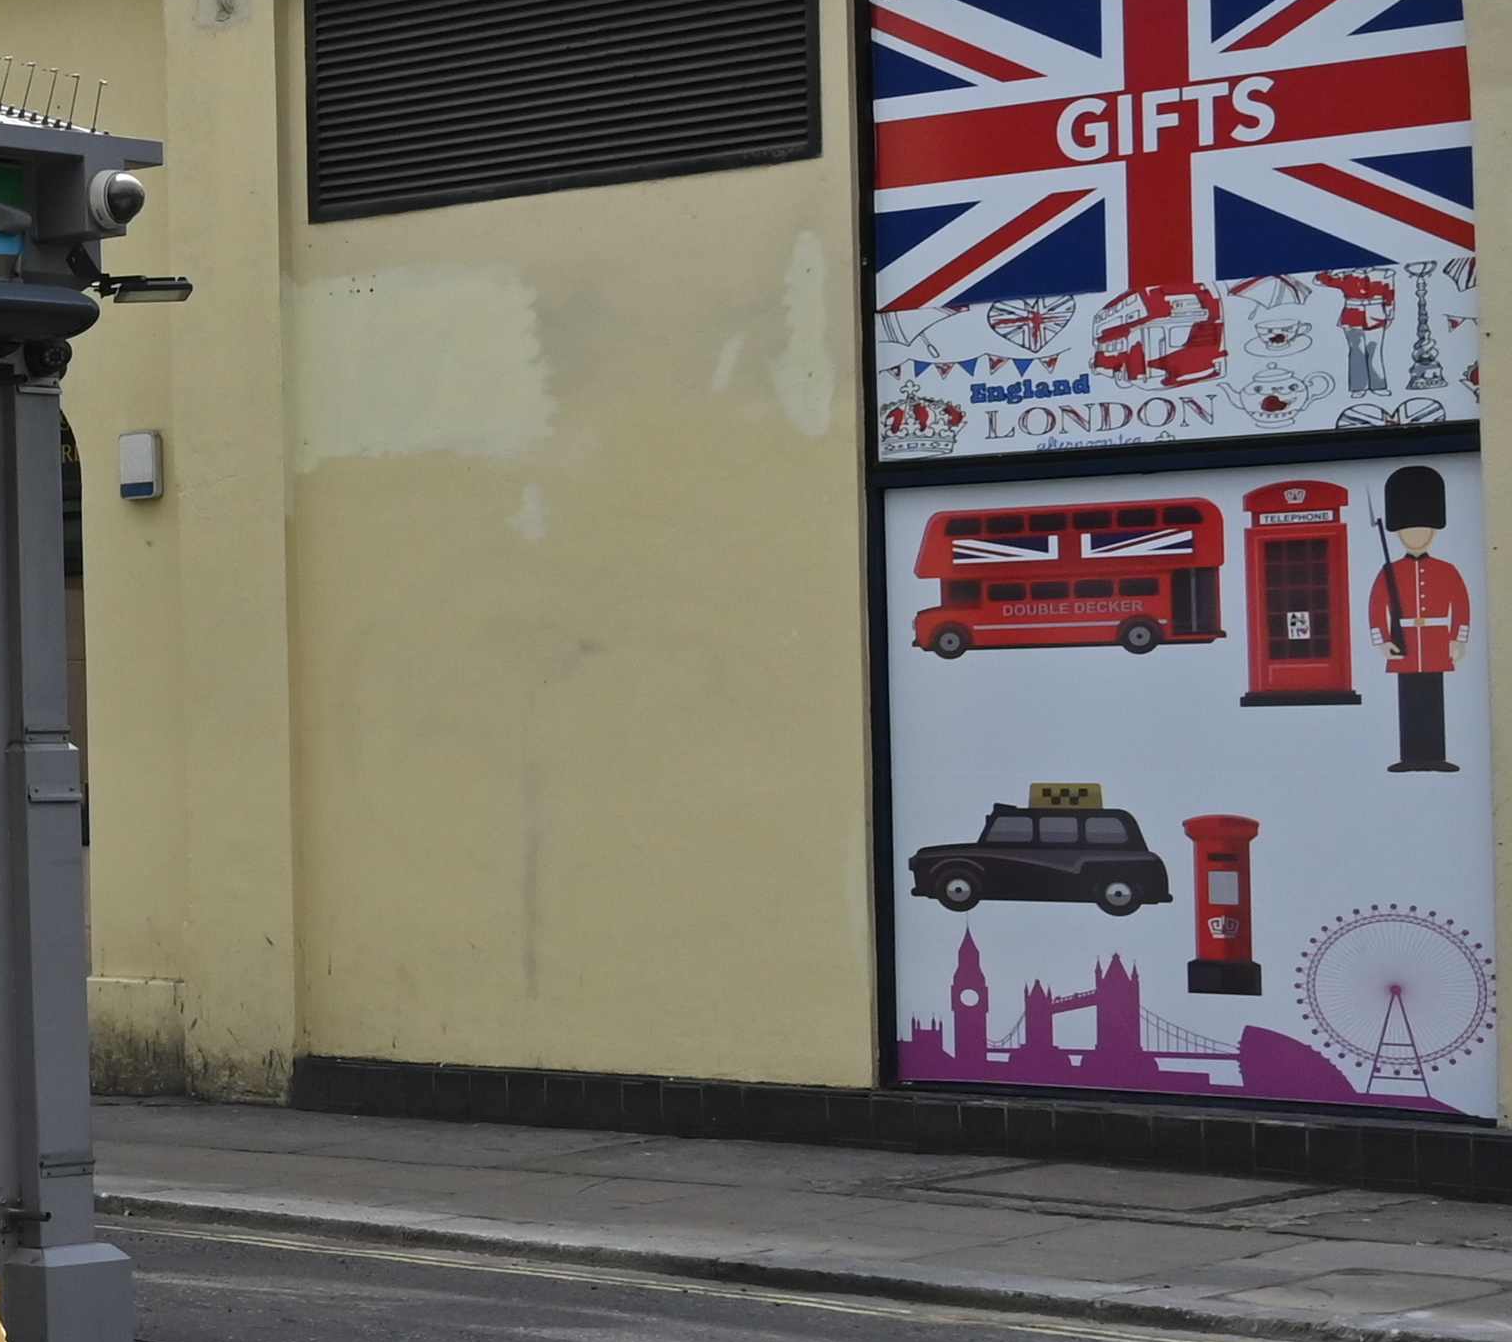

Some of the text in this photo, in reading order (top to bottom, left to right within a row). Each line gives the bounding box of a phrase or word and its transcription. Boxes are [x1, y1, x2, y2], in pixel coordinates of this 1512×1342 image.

[1056, 76, 1275, 162] GIFTS
[970, 373, 1090, 404] England
[984, 394, 1217, 439] LONDON
[1263, 512, 1330, 523] TELEPHONE
[1002, 600, 1144, 617] DOUBLE DECKER
